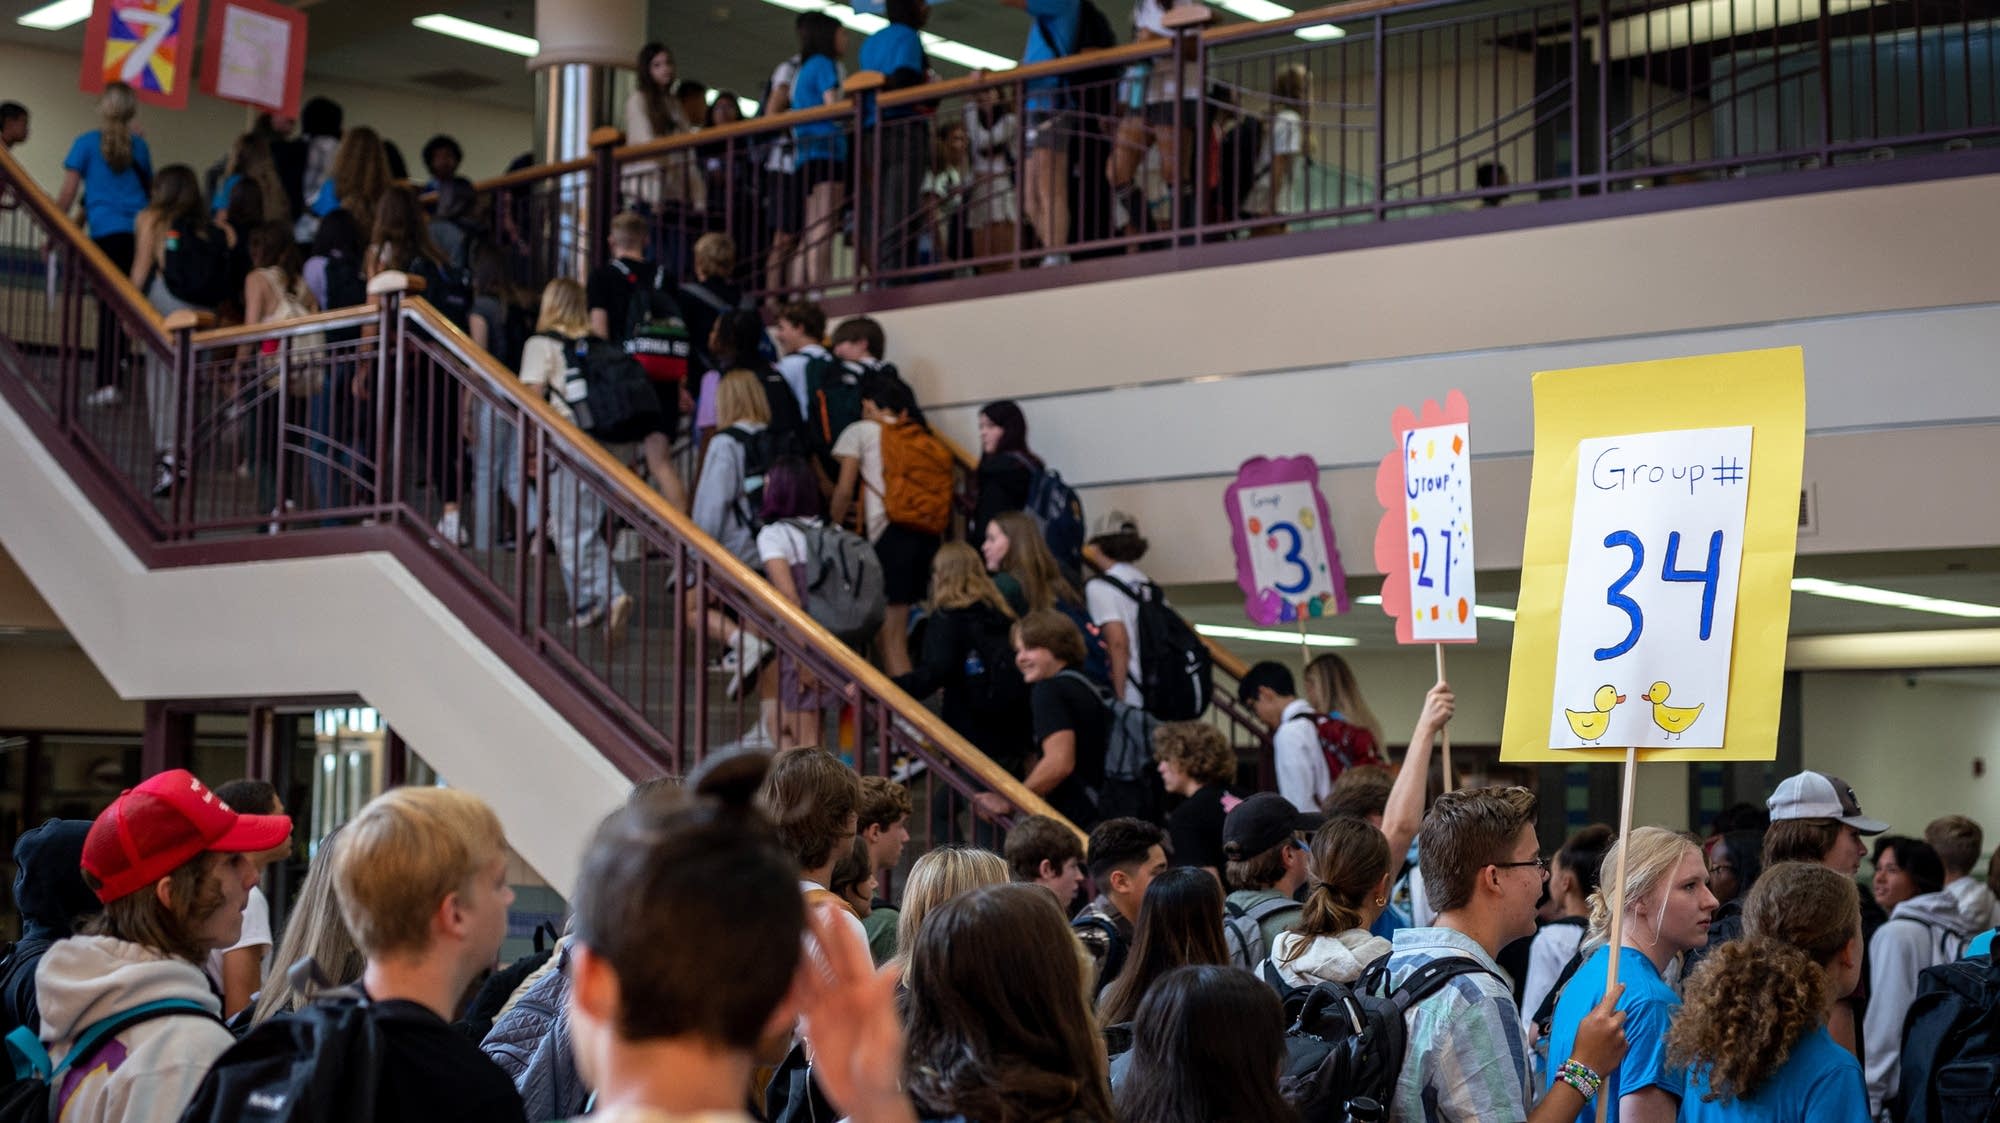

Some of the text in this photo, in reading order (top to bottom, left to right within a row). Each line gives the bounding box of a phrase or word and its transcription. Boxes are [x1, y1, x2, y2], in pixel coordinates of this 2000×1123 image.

[118, 8, 174, 81] 7
[1406, 431, 1450, 500] Group
[1267, 521, 1312, 594] 3
[1412, 527, 1452, 597] 27
[1593, 529, 1724, 662] 34
